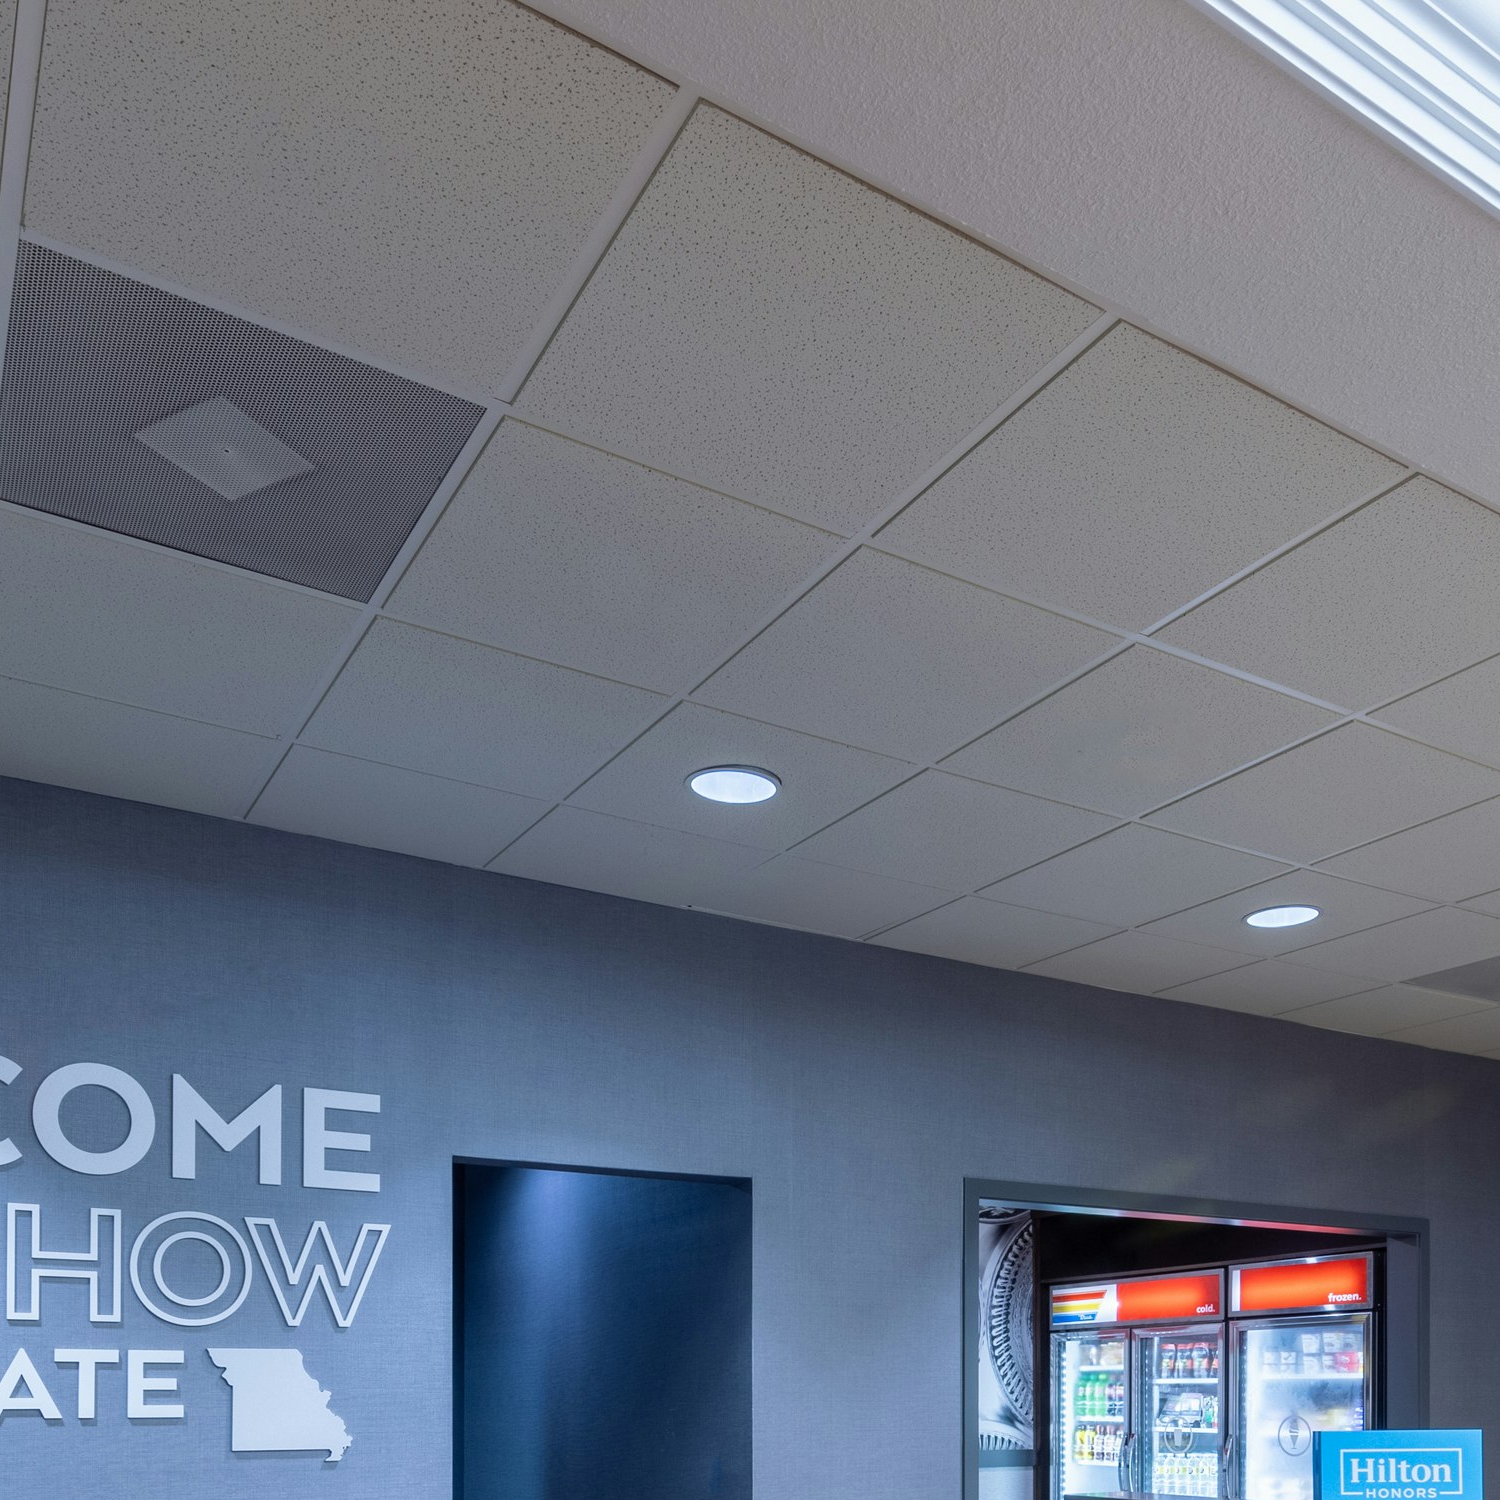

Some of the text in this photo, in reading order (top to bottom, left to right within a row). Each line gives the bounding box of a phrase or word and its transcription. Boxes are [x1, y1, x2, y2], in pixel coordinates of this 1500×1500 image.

[1327, 1292, 1362, 1303] frozen.
[1196, 1303, 1215, 1313] cold.
[1350, 1458, 1453, 1483] Hilton
[1366, 1487, 1438, 1499] HONORS
